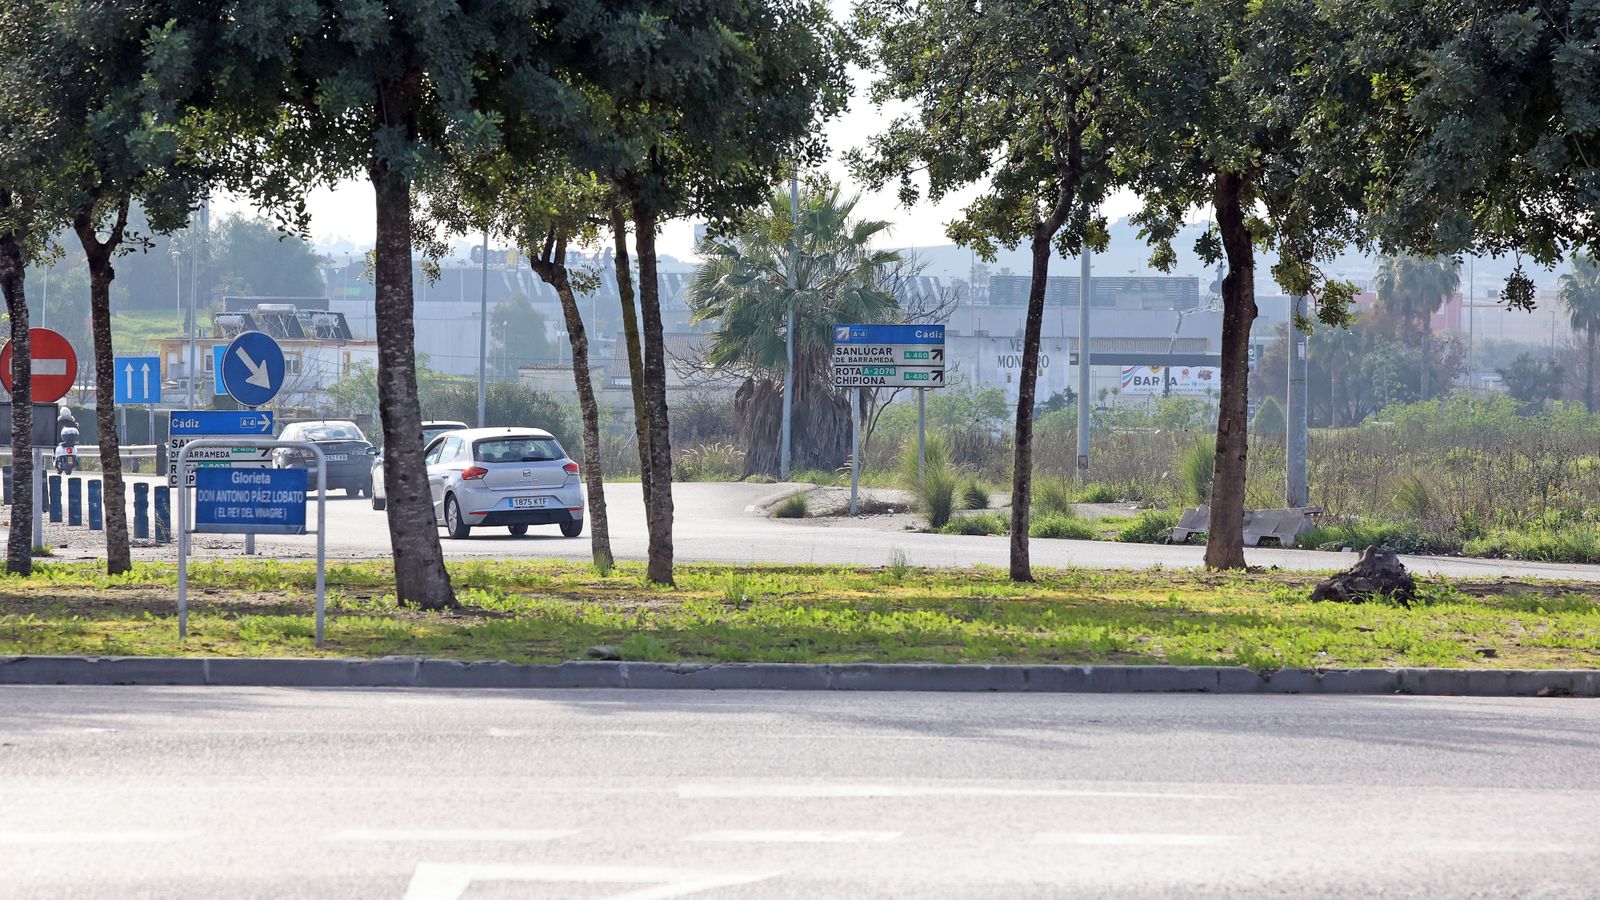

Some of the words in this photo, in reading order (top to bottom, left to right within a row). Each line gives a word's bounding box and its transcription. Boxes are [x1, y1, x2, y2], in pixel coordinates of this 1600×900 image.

[915, 330, 944, 338] Cádiz
[836, 345, 892, 356] SANLÚCAR
[836, 368, 862, 376] ROTA
[836, 376, 886, 384] CHIPIONA
[172, 418, 200, 428] Cádiz
[232, 472, 271, 484] Glorieta
[198, 490, 214, 502] DON
[216, 490, 250, 502] ANTONIO
[251, 487, 272, 502] PÁEZ
[272, 490, 304, 503] LOBATO
